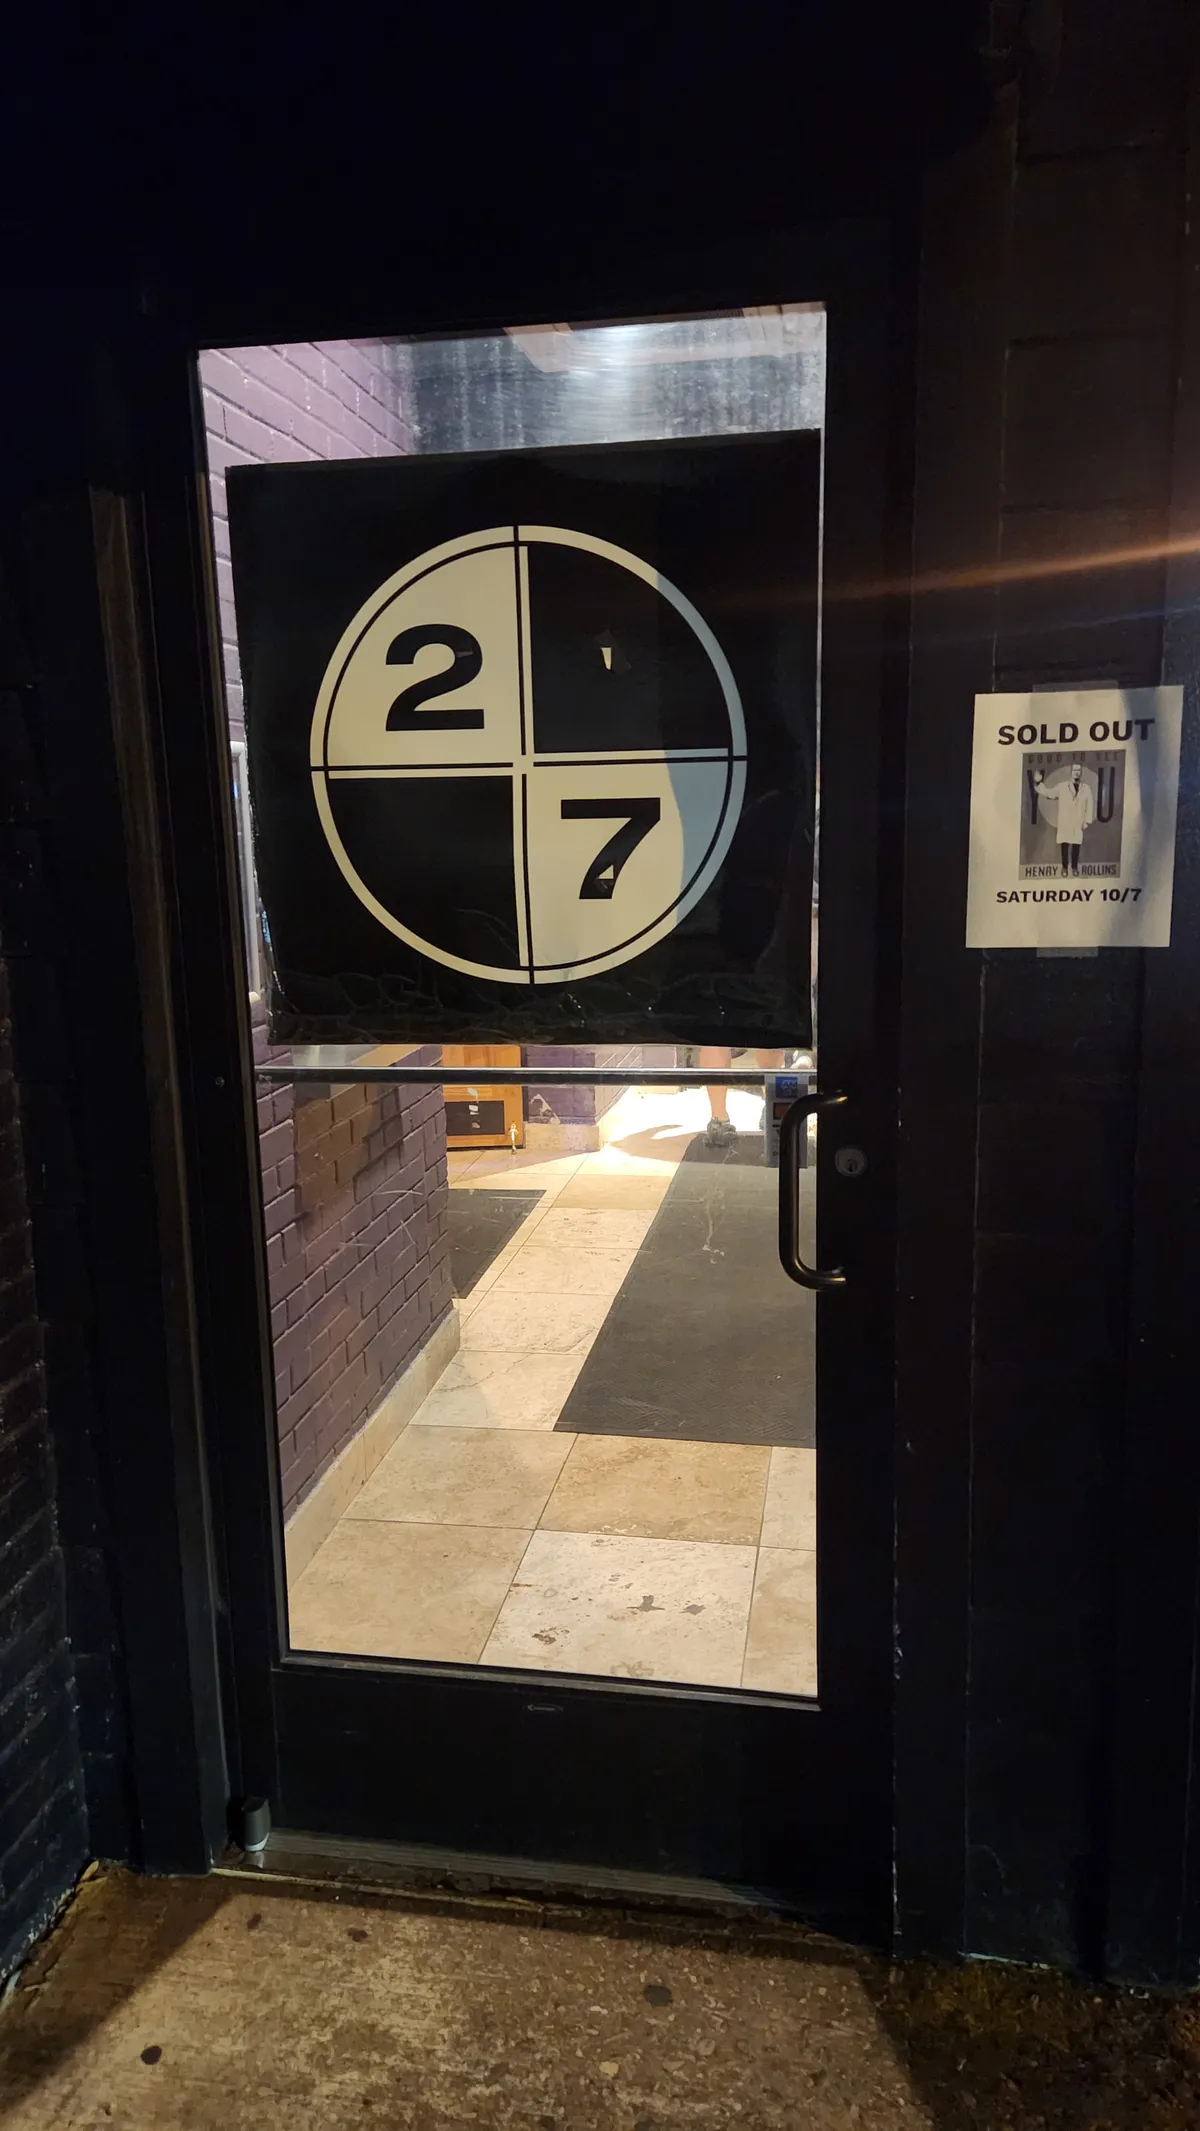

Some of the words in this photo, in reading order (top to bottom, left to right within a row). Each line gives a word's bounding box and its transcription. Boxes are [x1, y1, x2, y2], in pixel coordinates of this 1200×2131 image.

[385, 623, 484, 732] 2
[998, 722, 1079, 746] SOLD
[1090, 718, 1156, 742] OUT
[560, 797, 661, 900] 7
[1025, 866, 1058, 877] HENRY
[1081, 864, 1117, 876] ROLLINS
[996, 889, 1094, 903] SATURDAY
[1100, 888, 1142, 903] 10/7
